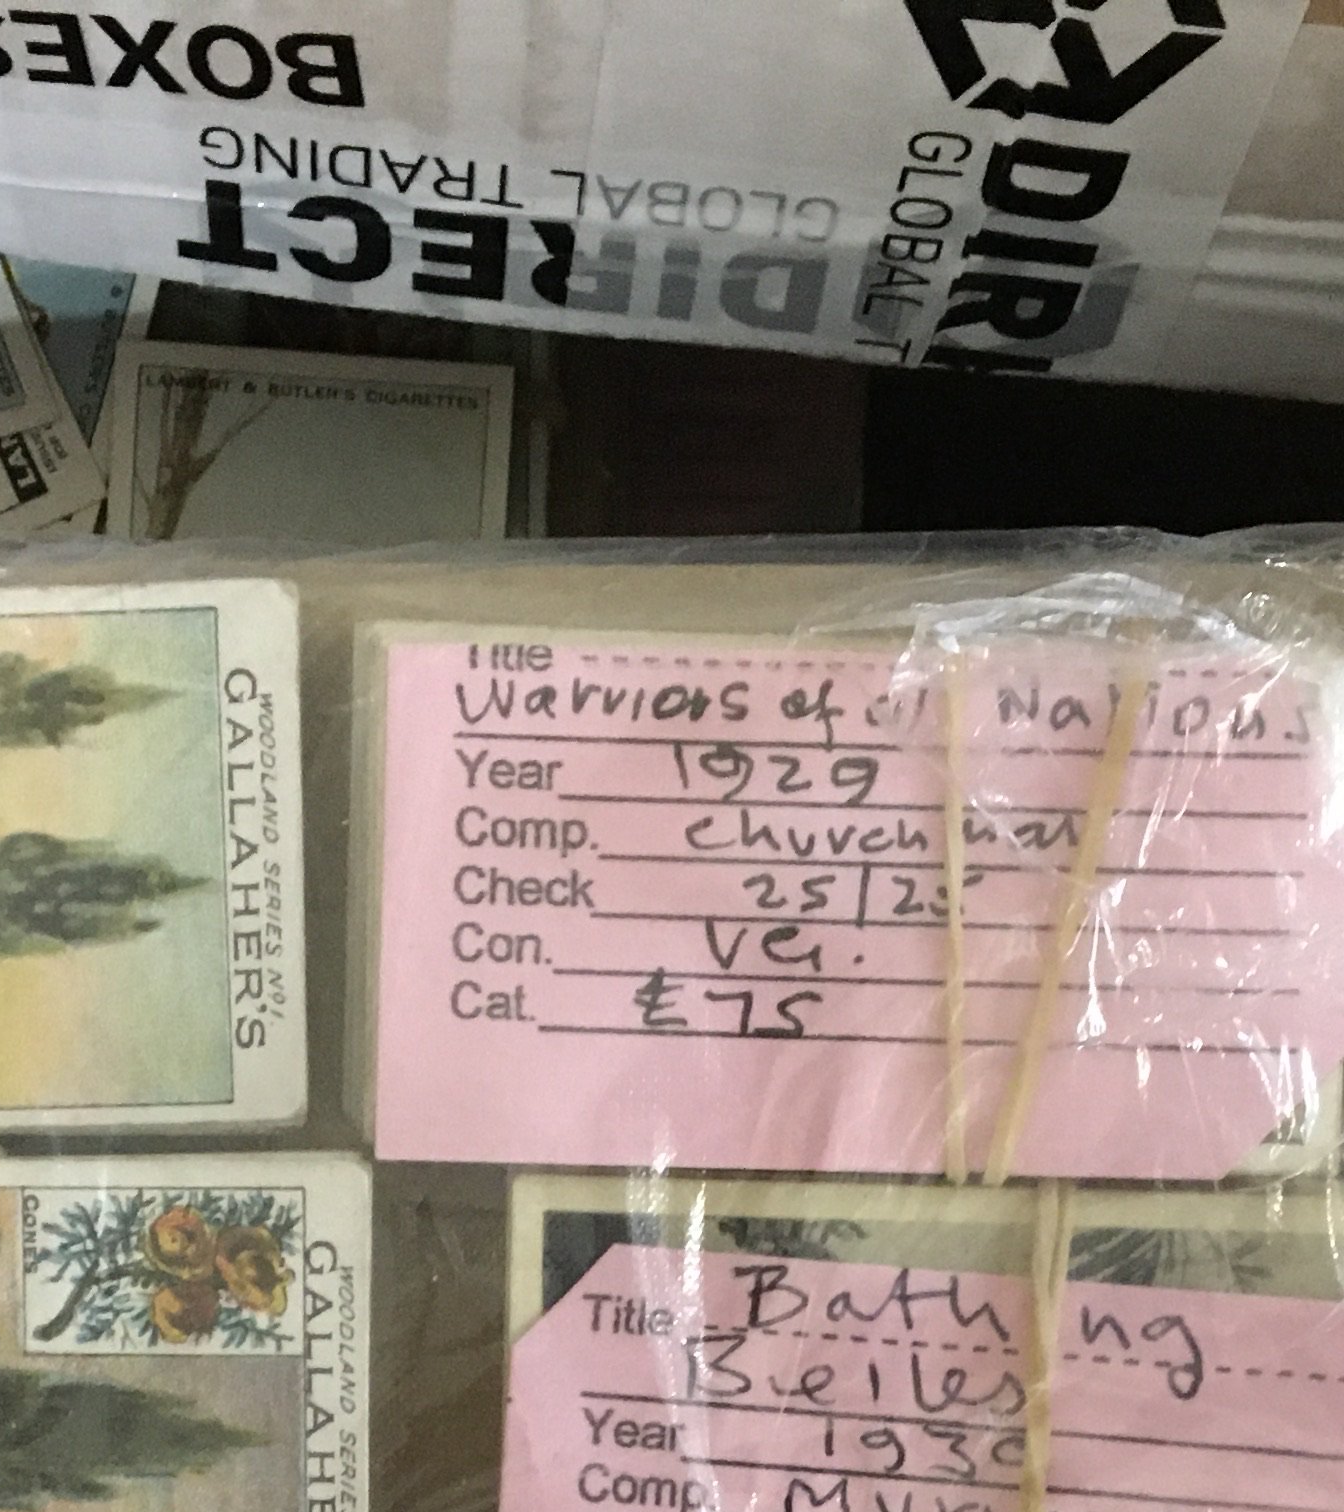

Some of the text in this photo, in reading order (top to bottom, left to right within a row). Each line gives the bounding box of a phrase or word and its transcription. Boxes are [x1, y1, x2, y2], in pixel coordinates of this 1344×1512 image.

[199, 126, 841, 244] GLOBAL TRADING
[863, 131, 972, 315] GLOBAL
[177, 179, 829, 333] DIRECT
[242, 382, 258, 396] &
[267, 383, 356, 403] BUTLER'S
[365, 388, 480, 411] CIGARETTES
[782, 681, 846, 748] of
[258, 692, 280, 846] WOODLAND
[457, 741, 879, 803] Year 1929
[224, 667, 268, 1051] GALLAHER'S
[456, 810, 600, 859] Comp.
[262, 859, 284, 955] SERIES
[456, 867, 595, 909] Check
[452, 925, 553, 964] Con.
[449, 981, 536, 1022] Cat.
[21, 1193, 41, 1276] CONES
[337, 1264, 357, 1415] WOODLAND
[583, 1263, 1206, 1400] Title Bathng
[581, 1409, 682, 1451] Year
